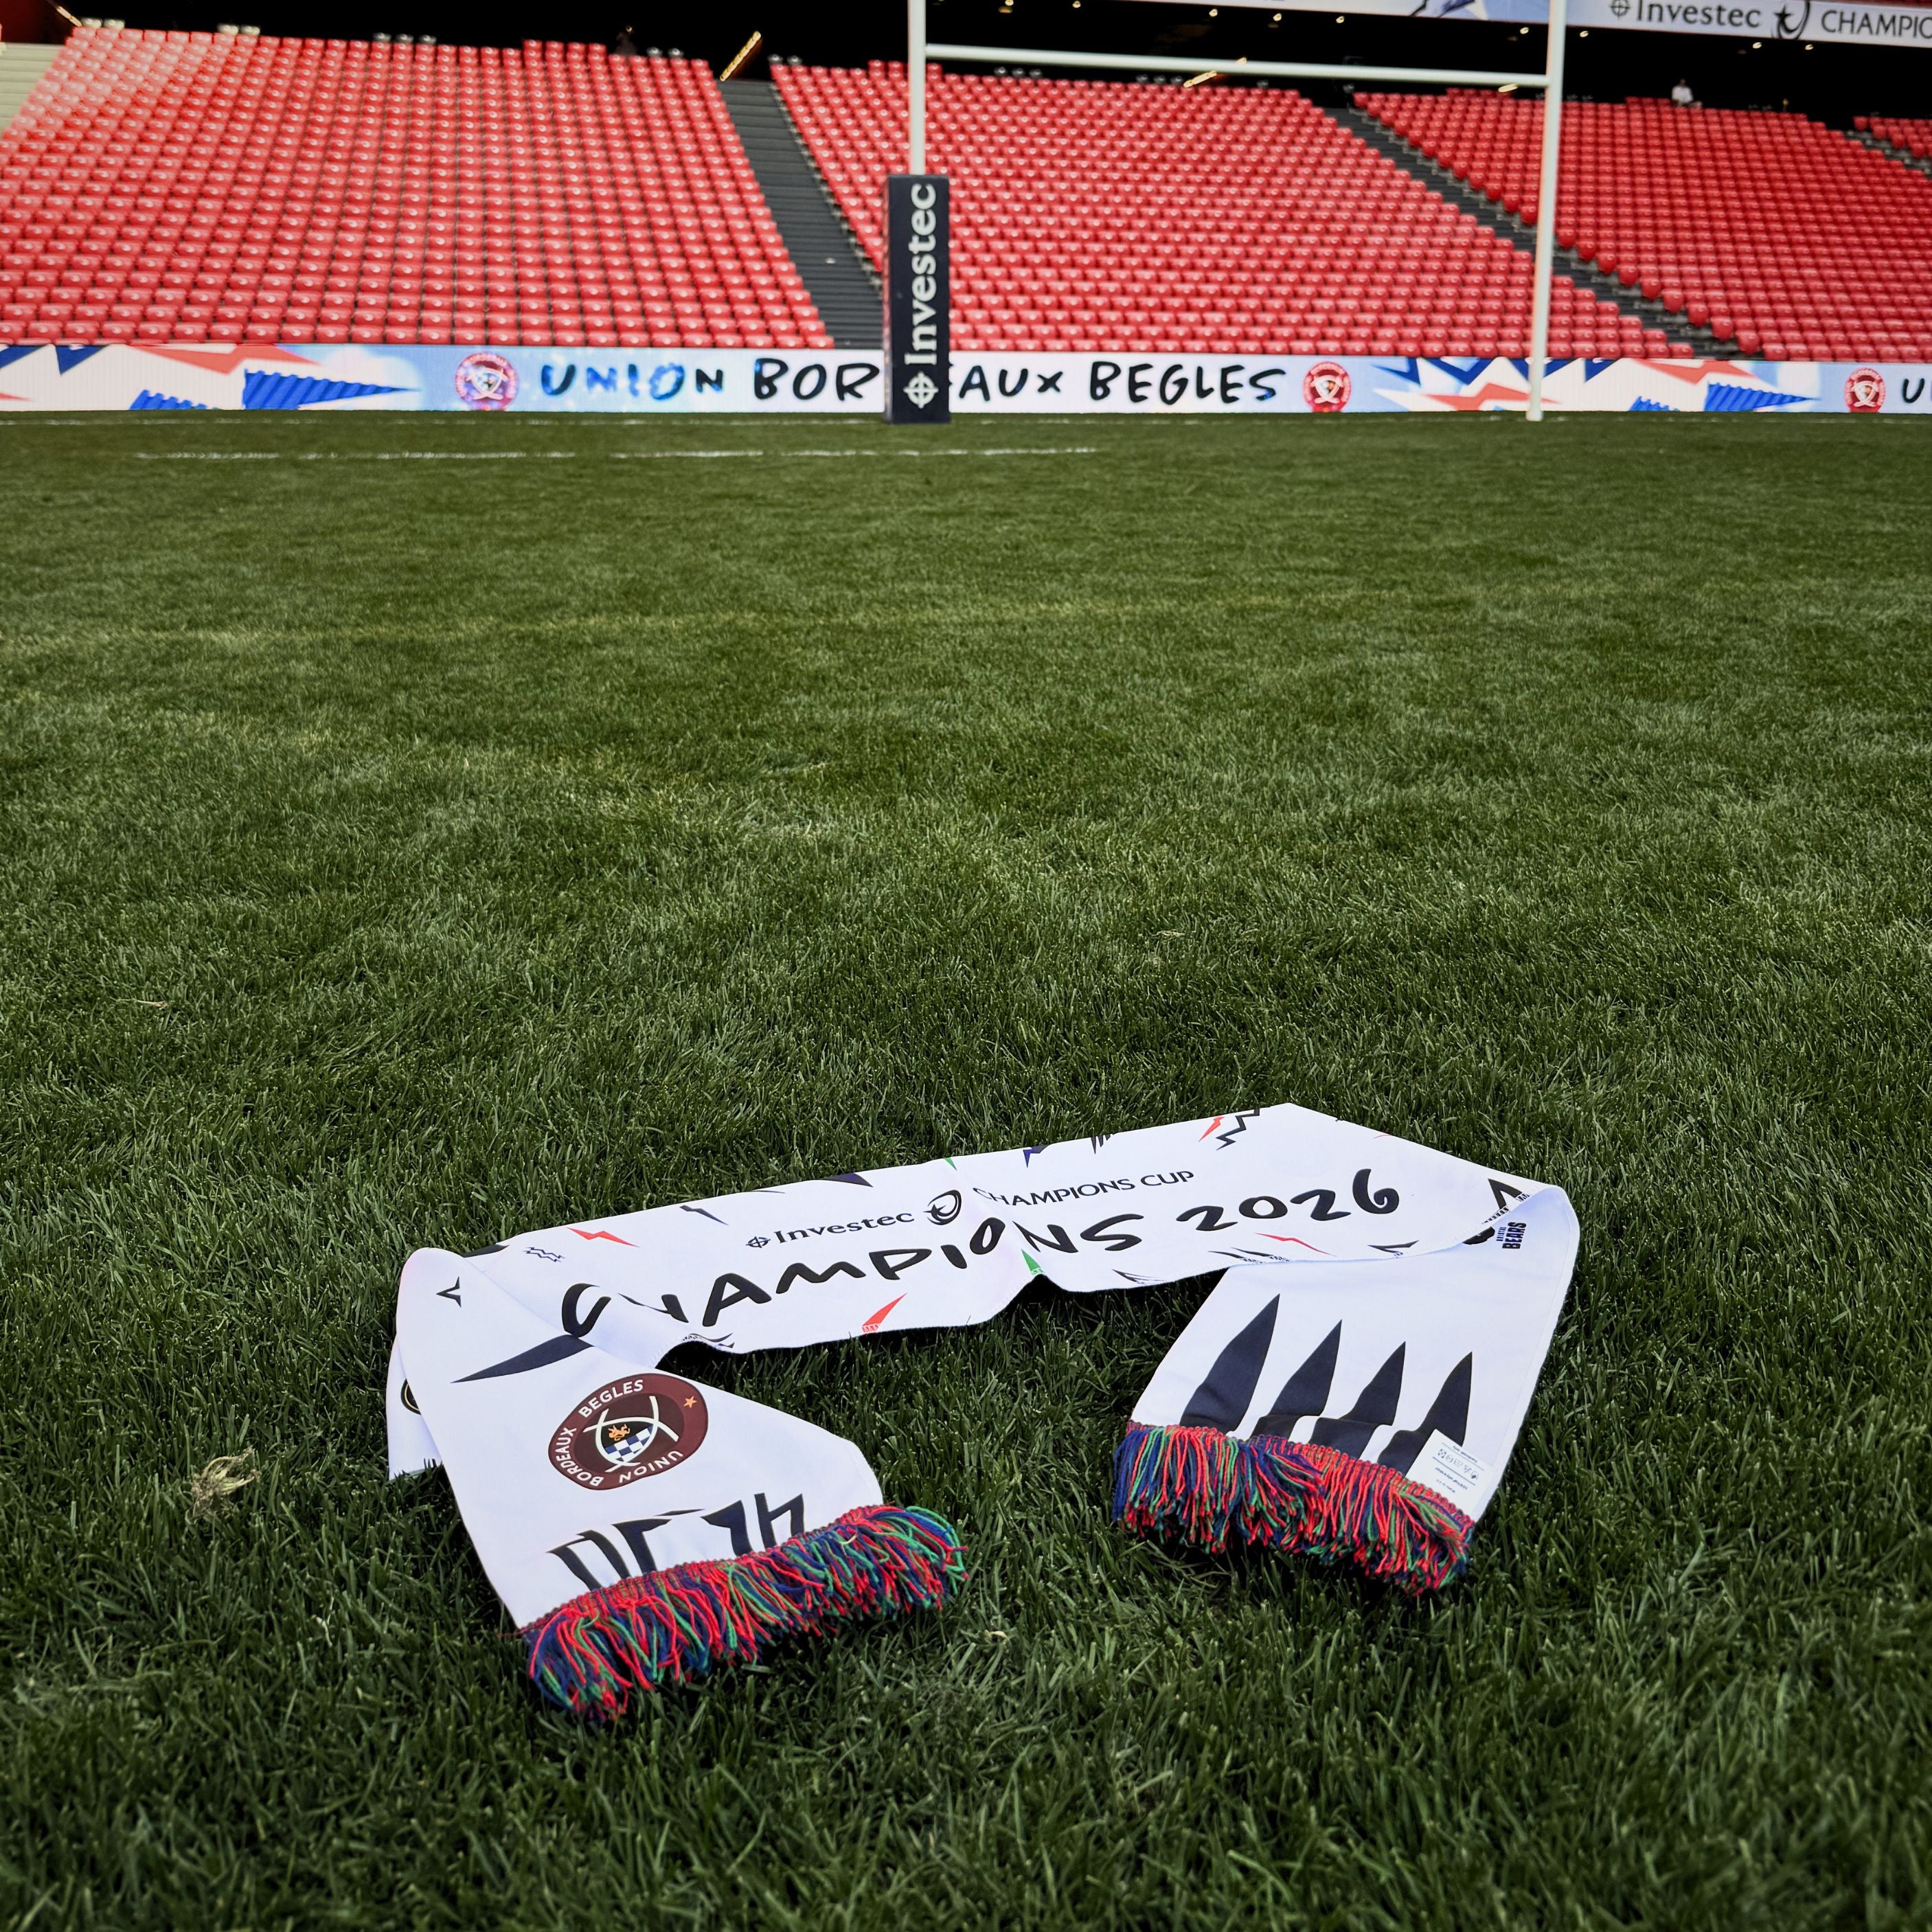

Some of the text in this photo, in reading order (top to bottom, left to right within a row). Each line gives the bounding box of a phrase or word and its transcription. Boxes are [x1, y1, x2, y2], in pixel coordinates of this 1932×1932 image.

[1636, 0, 1761, 28] Investec
[904, 183, 937, 365] Investec
[541, 363, 724, 401] UNION
[753, 358, 1062, 402] BORAUX
[1090, 361, 1286, 405] BEGLES
[773, 1170, 1195, 1244] Investec CHAMPIONS CUP
[1176, 1168, 1400, 1231] 2026
[1501, 1221, 1527, 1249] BEARS
[578, 1378, 644, 1418] BEGLES
[555, 1427, 604, 1487] BORDEAUX
[619, 1450, 683, 1484] UNION
